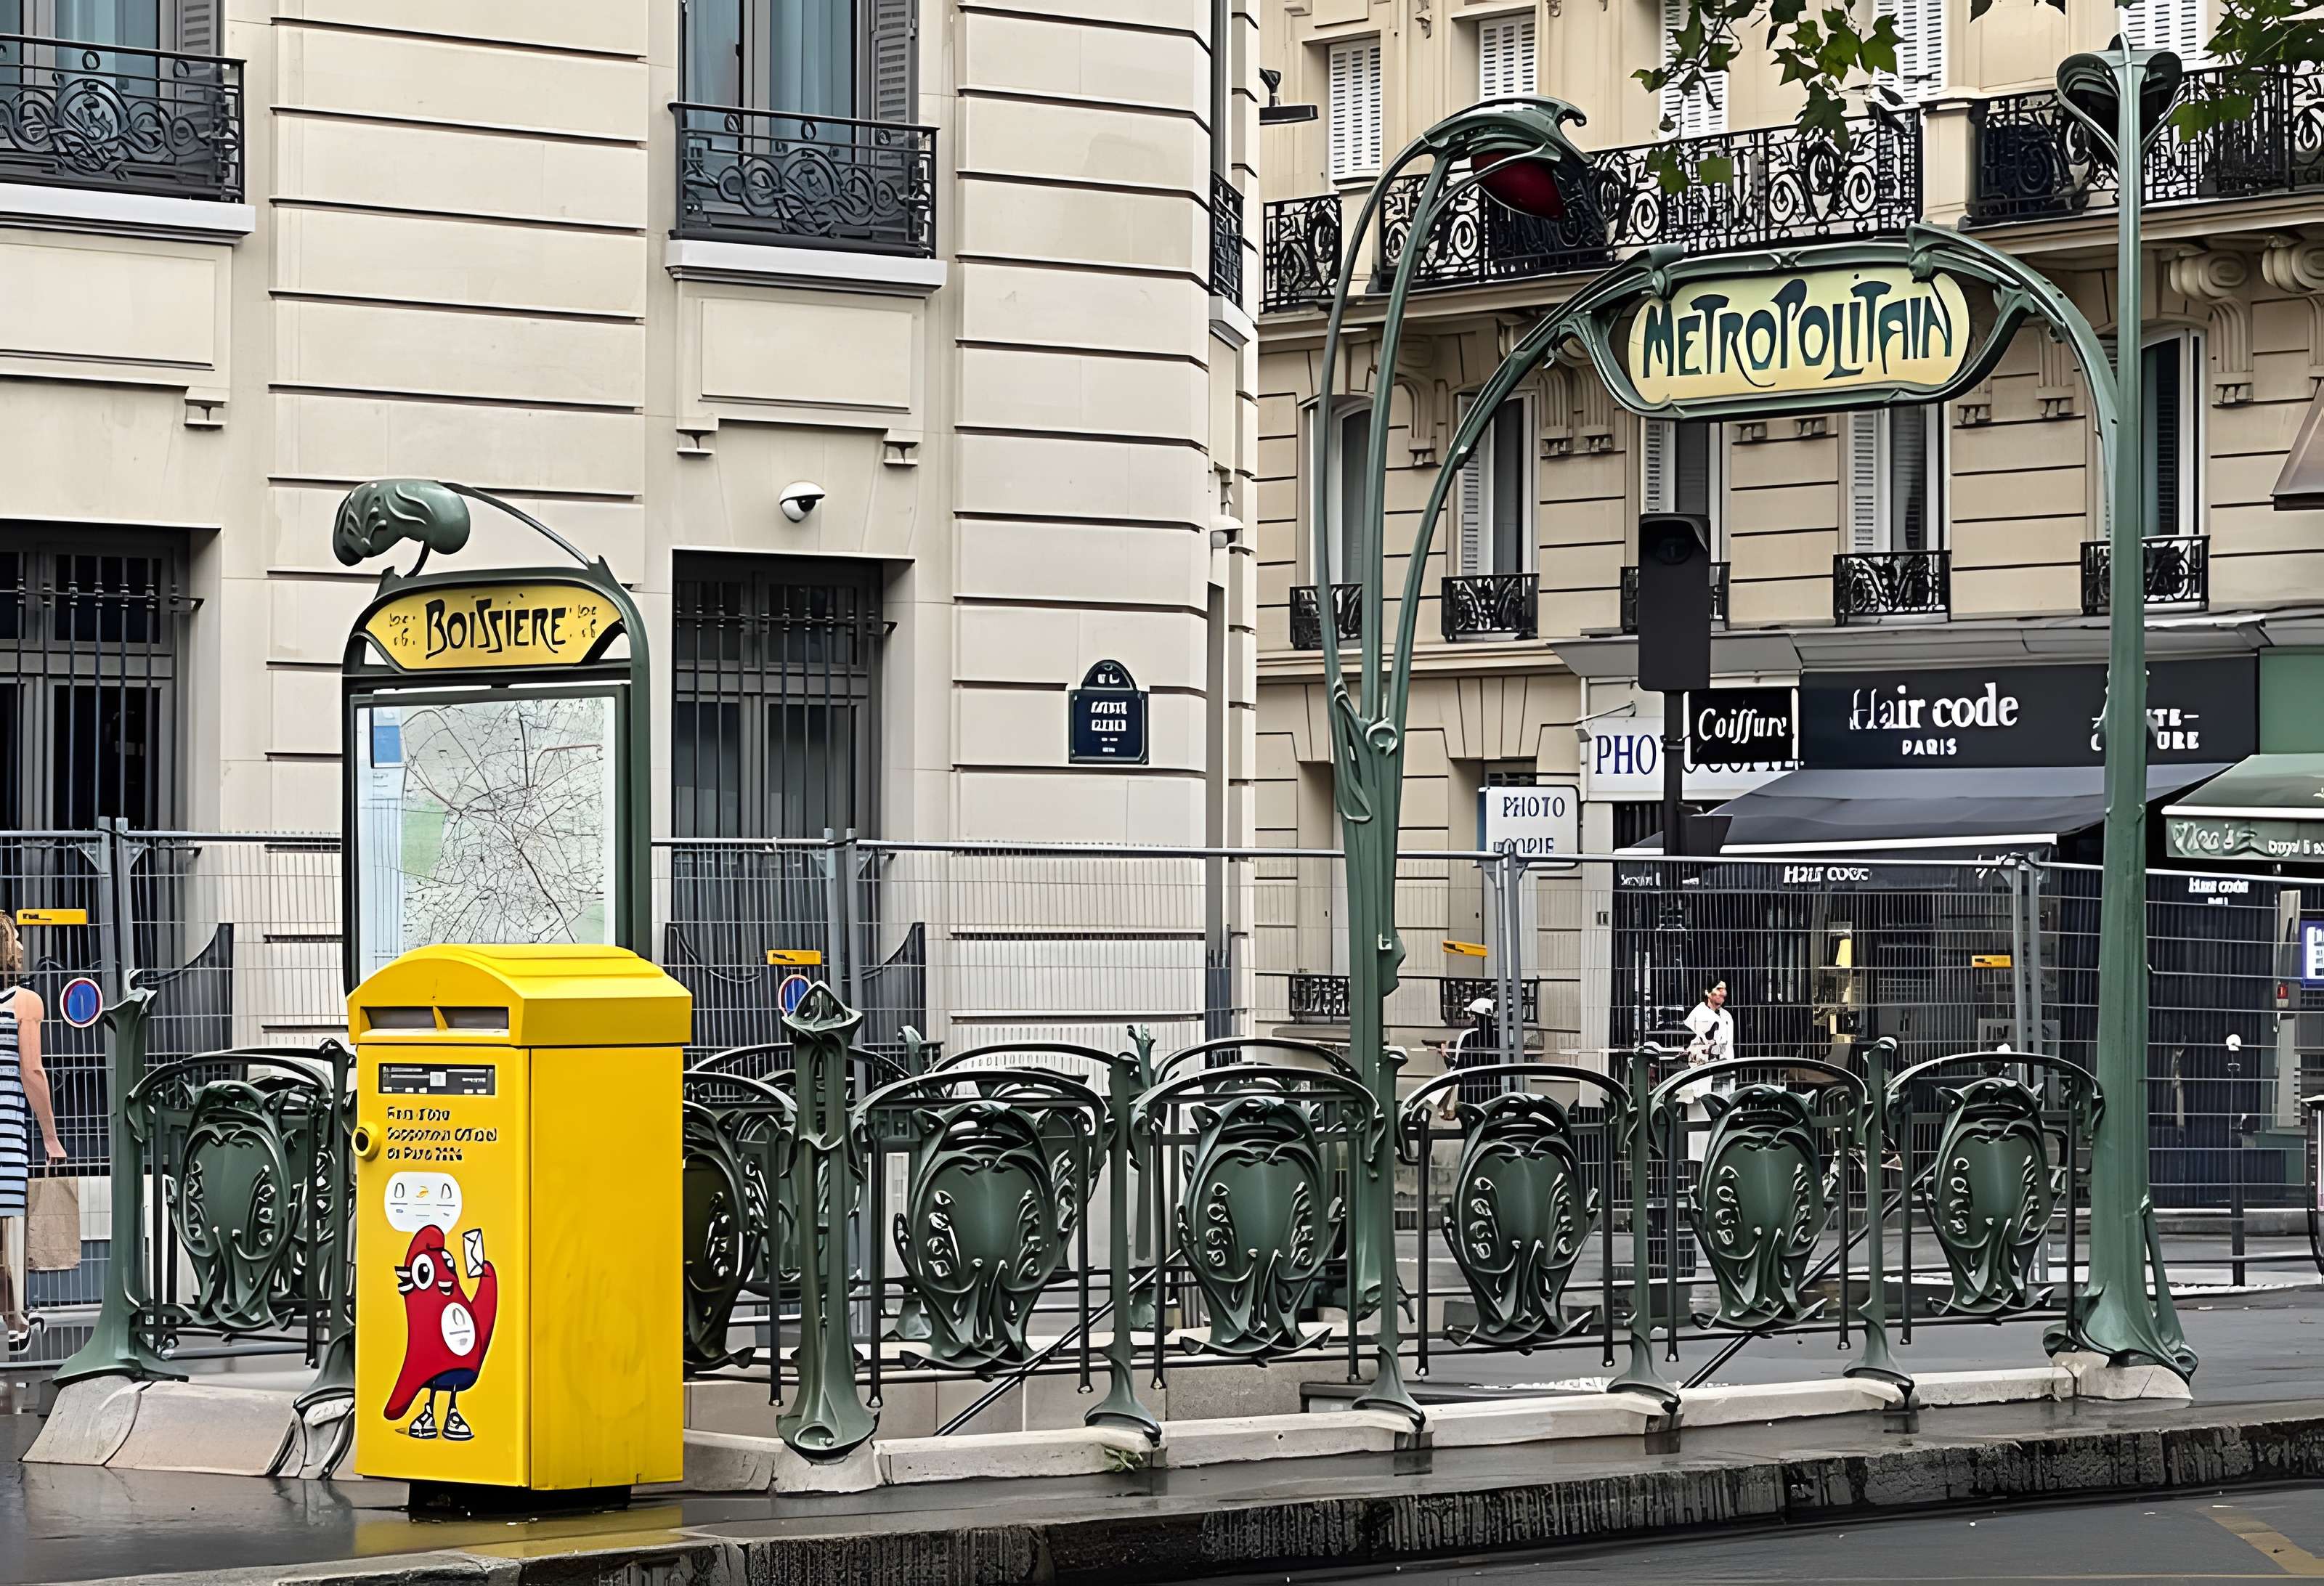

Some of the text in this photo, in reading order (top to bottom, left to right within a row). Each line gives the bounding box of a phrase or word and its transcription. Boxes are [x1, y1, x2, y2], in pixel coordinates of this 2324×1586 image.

[1643, 274, 1952, 387] METROPOLITAIN
[426, 593, 566, 659] BOISSIÈRE
[1698, 707, 1787, 744] Coiffure
[1849, 683, 2019, 729] Hair code
[1901, 738, 1957, 756] PARIS
[1503, 797, 1566, 818] PHOTO
